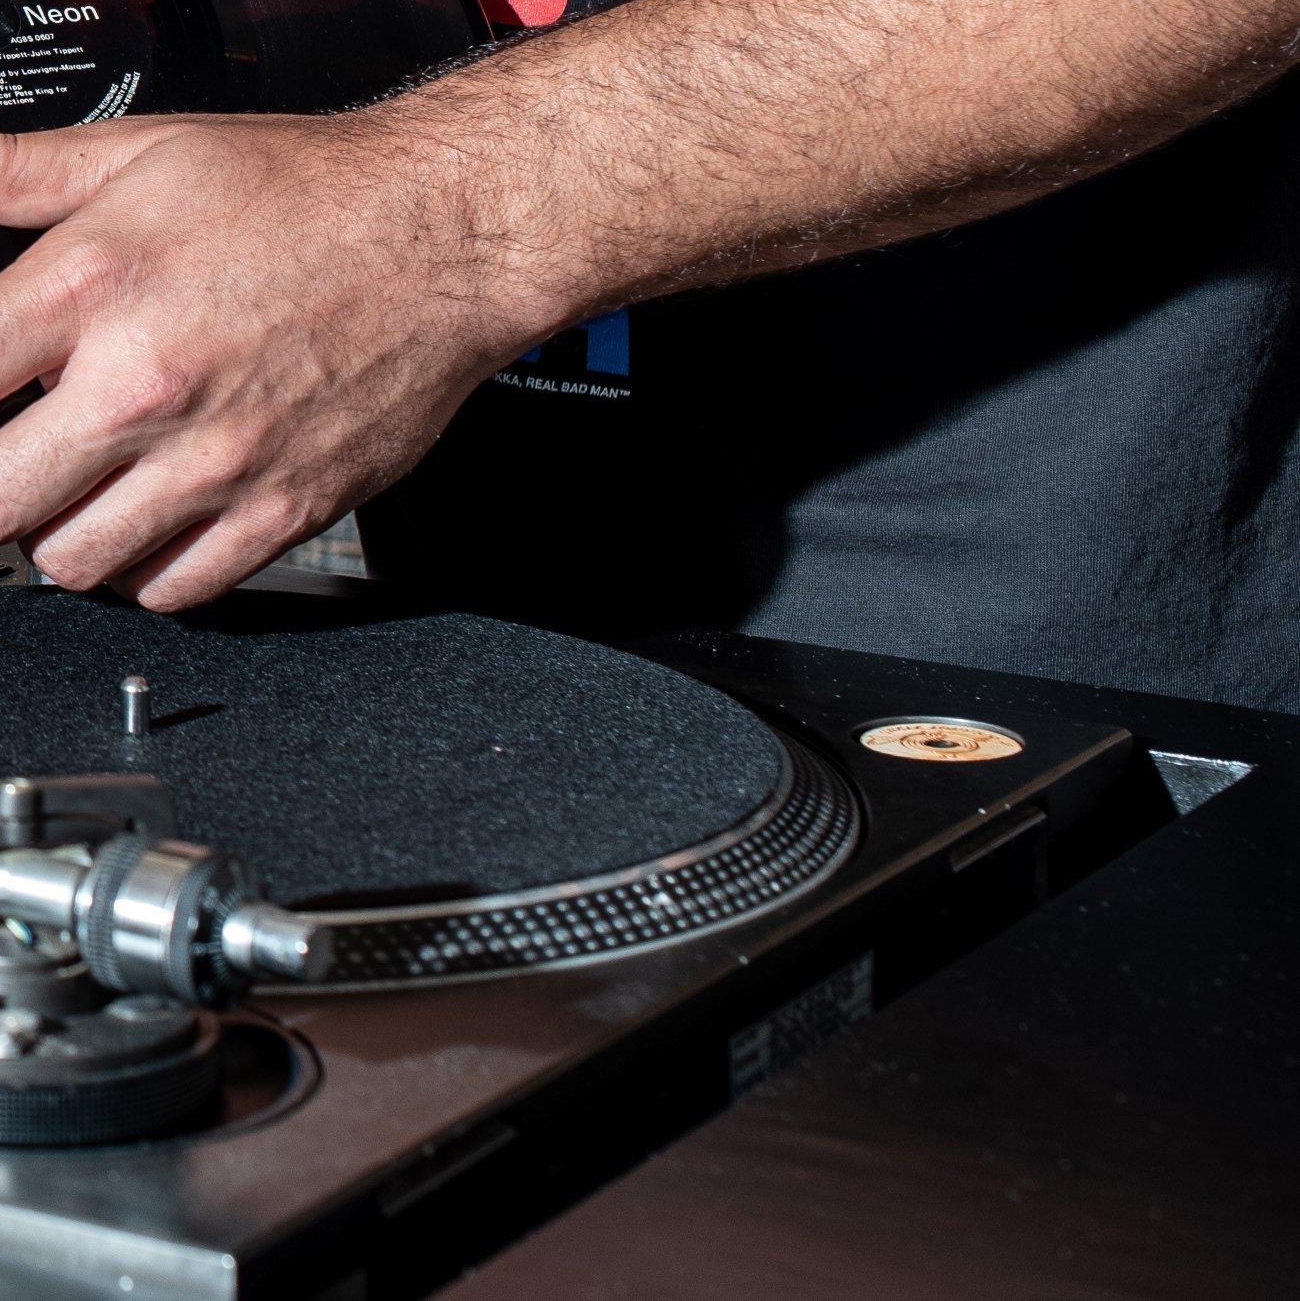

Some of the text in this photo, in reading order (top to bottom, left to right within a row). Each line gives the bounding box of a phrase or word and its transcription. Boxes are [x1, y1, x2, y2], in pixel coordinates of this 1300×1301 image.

[22, 4, 100, 26] Neon
[53, 46, 84, 55] Tippett
[7, 69, 19, 77] by
[21, 62, 96, 76] Louvigny-Marquee
[0, 84, 23, 93] Fripp
[14, 89, 33, 98] Pete
[35, 87, 55, 96] King
[526, 377, 558, 392] REAL
[561, 382, 588, 394] BAD
